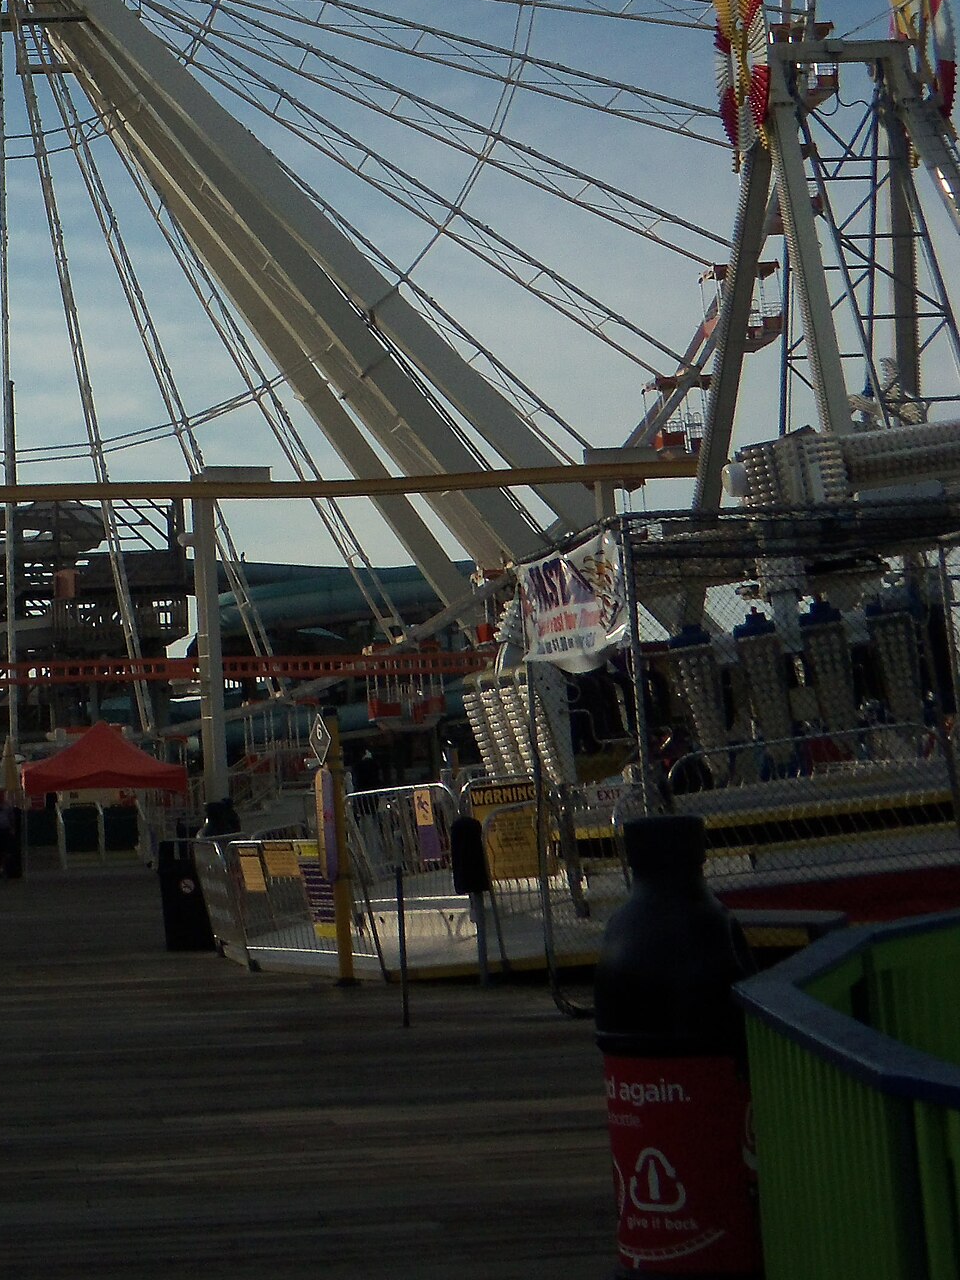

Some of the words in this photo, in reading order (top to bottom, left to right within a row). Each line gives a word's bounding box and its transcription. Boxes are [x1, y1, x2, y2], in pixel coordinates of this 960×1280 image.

[316, 723, 323, 740] 6
[597, 789, 622, 801] EXIT
[619, 1077, 691, 1107] again.
[664, 1216, 699, 1231] back
